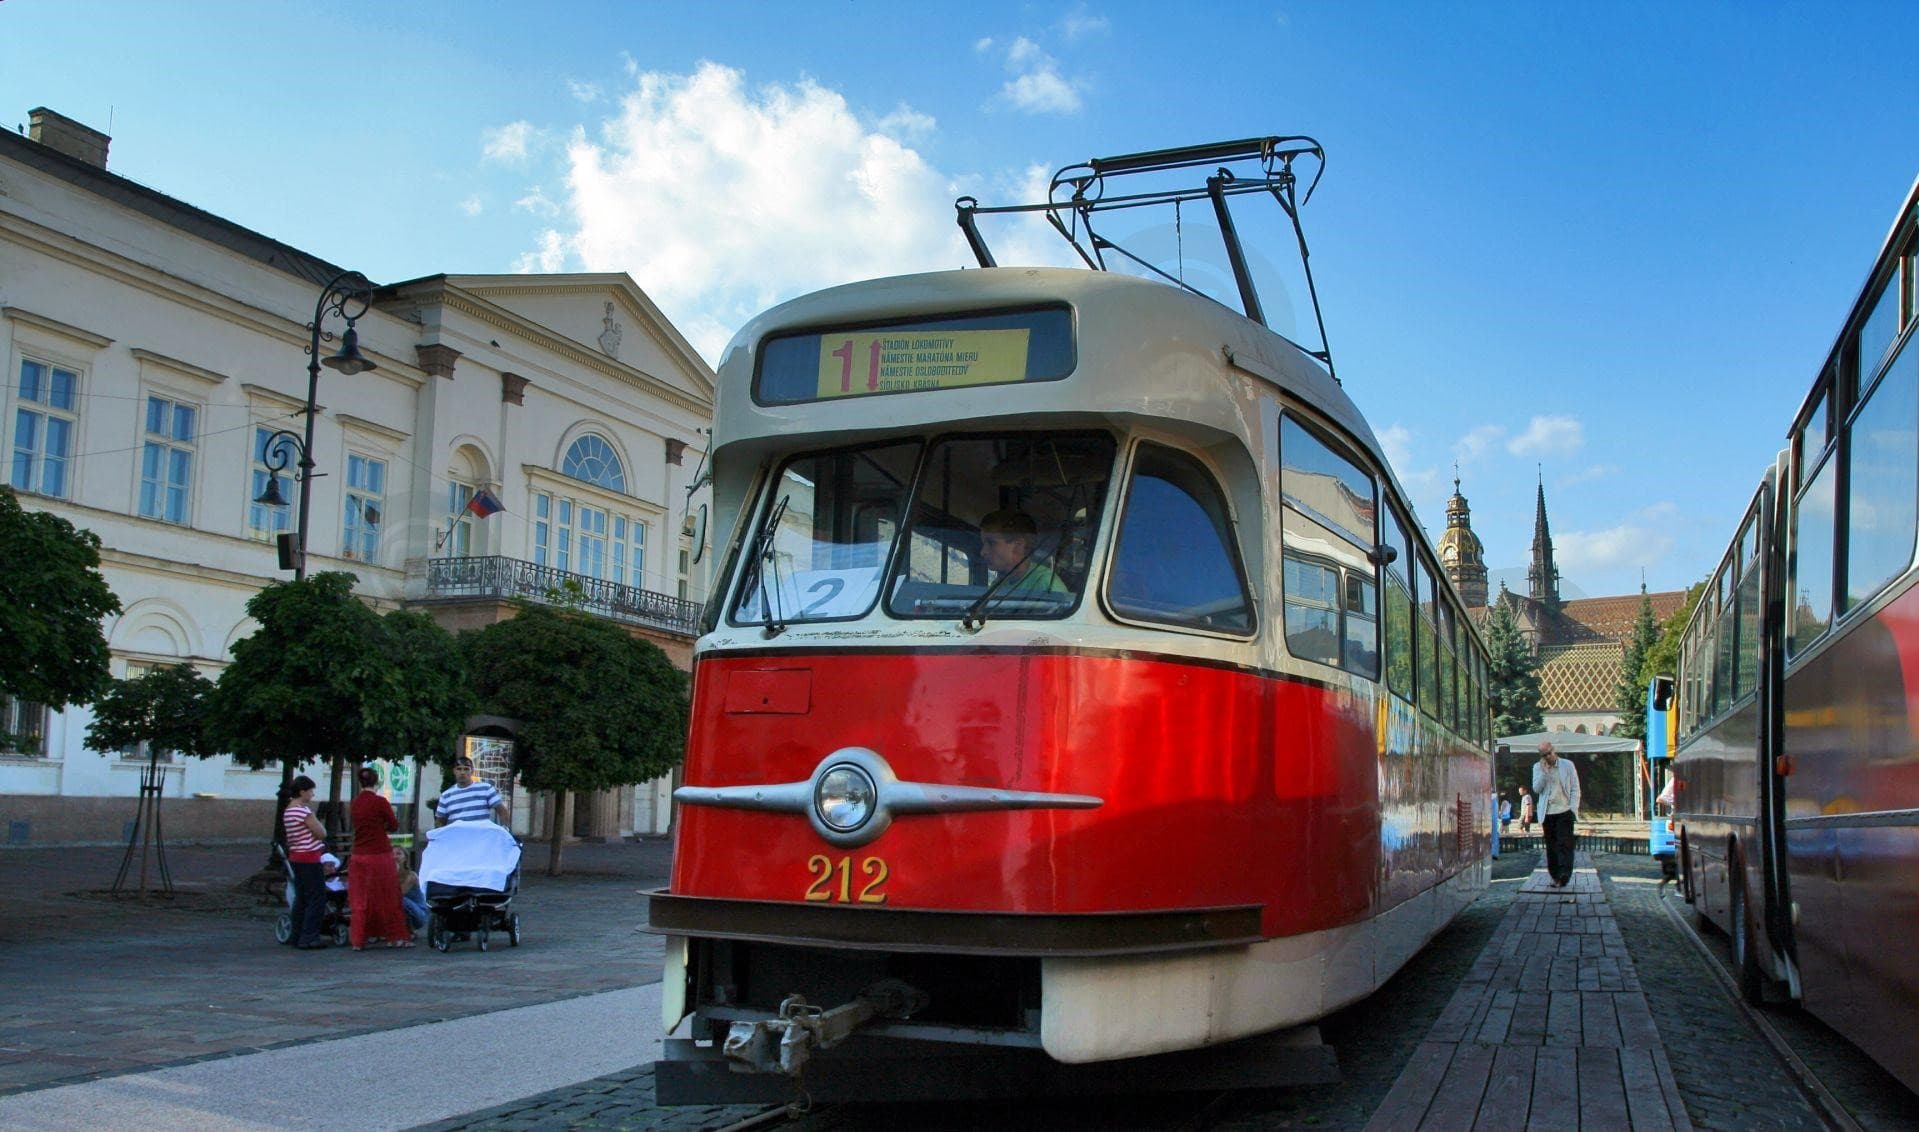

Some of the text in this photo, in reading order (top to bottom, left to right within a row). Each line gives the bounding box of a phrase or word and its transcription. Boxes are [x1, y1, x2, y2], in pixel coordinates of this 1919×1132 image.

[880, 365, 913, 376] NÁMESTIE
[881, 352, 913, 363] NÁMESTIE
[792, 577, 845, 618] 2
[804, 855, 889, 903] 212
